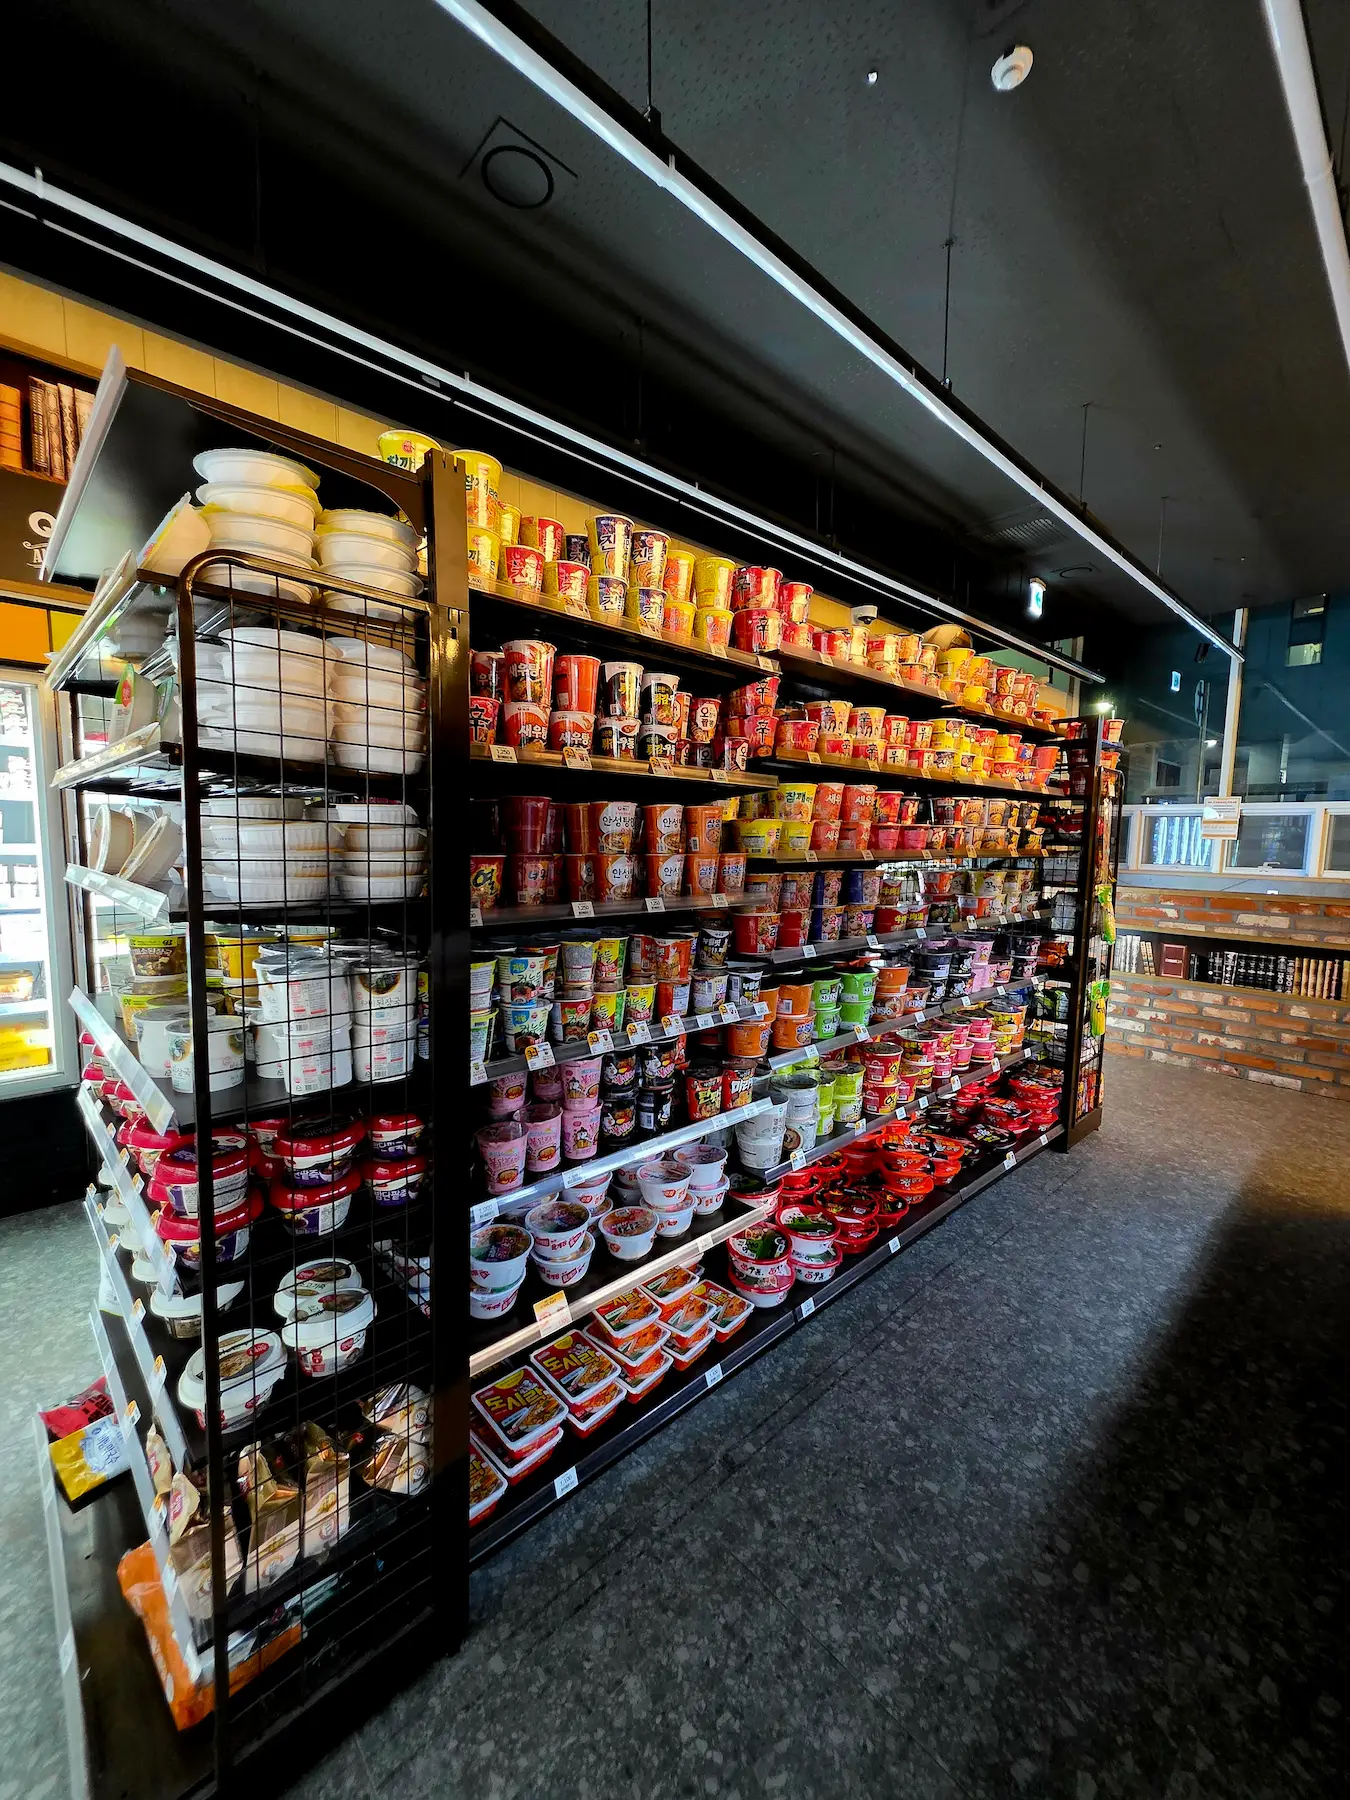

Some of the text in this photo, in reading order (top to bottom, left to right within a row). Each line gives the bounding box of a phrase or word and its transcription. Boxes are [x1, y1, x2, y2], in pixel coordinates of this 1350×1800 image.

[509, 663, 542, 681] 새우탕
[614, 1290, 642, 1307] 시락
[543, 1350, 600, 1371] 도시락
[485, 1387, 547, 1411] 도시락
